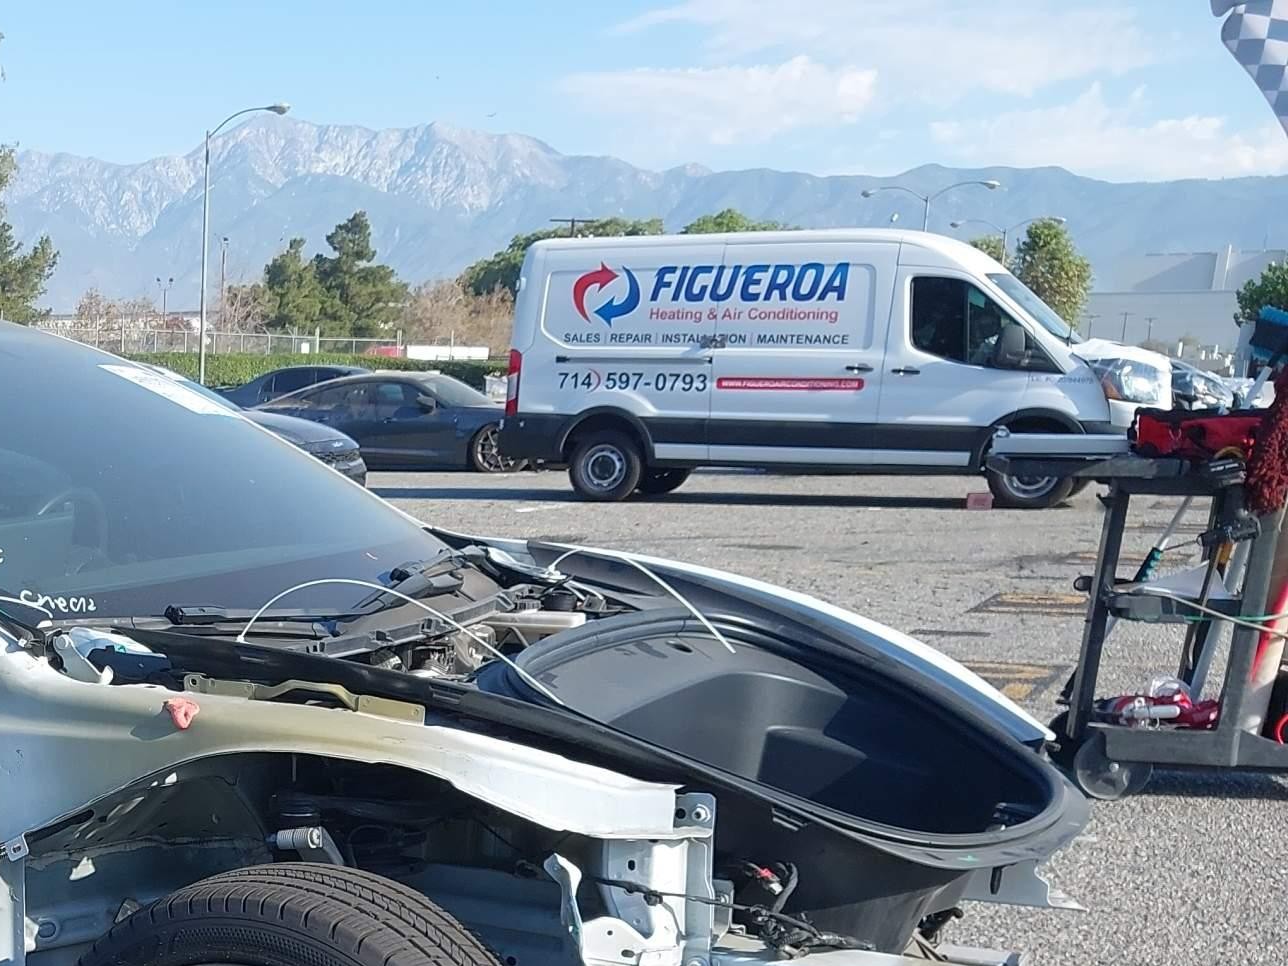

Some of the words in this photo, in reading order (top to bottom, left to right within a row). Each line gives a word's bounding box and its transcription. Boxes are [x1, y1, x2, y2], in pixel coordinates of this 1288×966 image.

[649, 262, 851, 303] FIGUEROA
[649, 307, 703, 324] Heating
[707, 307, 718, 321] &
[722, 307, 743, 321] Air
[747, 308, 839, 324] Conditioning
[563, 332, 601, 344] SALES
[609, 332, 653, 345] REPAIR
[756, 333, 850, 345] MAINTENANCE
[605, 371, 708, 392] 597-0793
